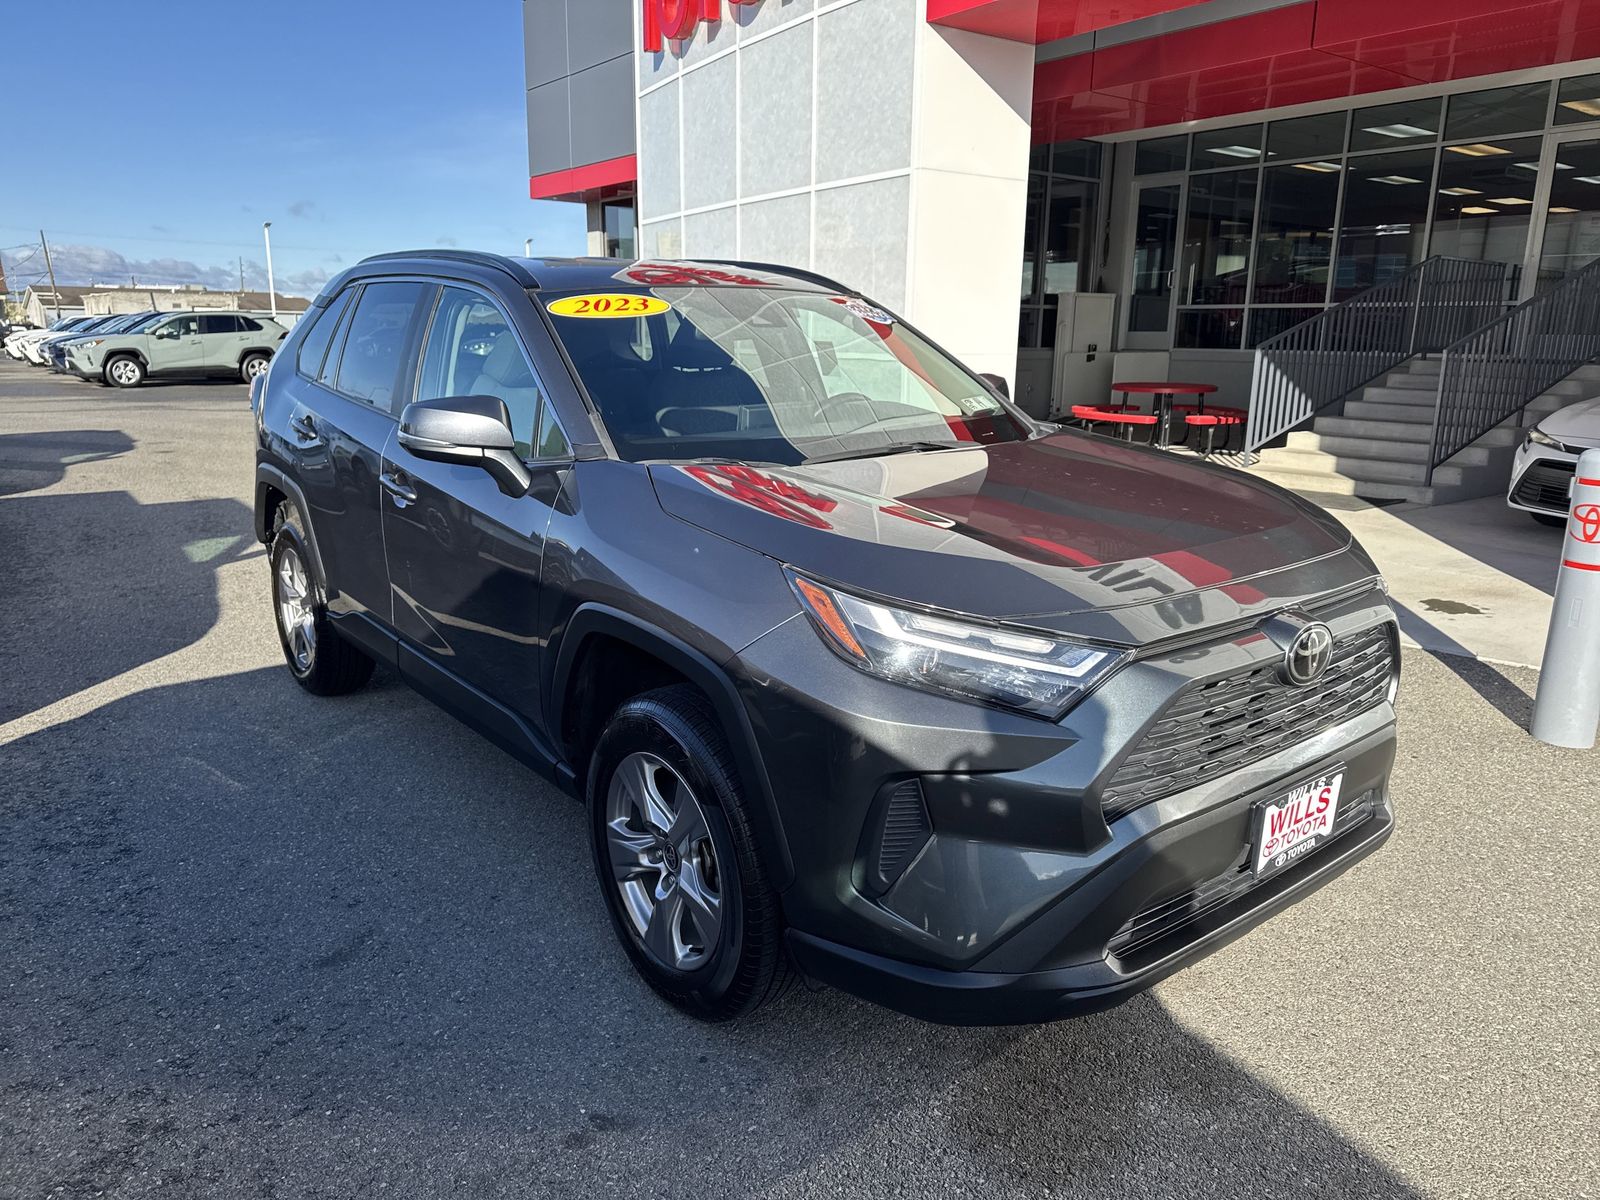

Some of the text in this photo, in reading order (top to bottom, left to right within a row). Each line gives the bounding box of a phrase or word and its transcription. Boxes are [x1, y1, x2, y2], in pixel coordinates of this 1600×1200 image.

[573, 298, 649, 313] 2023
[1287, 777, 1327, 803] WILLS
[1270, 787, 1331, 837] WILLS
[1280, 814, 1327, 848] TOYOTA
[1287, 838, 1316, 860] TOYOTA
